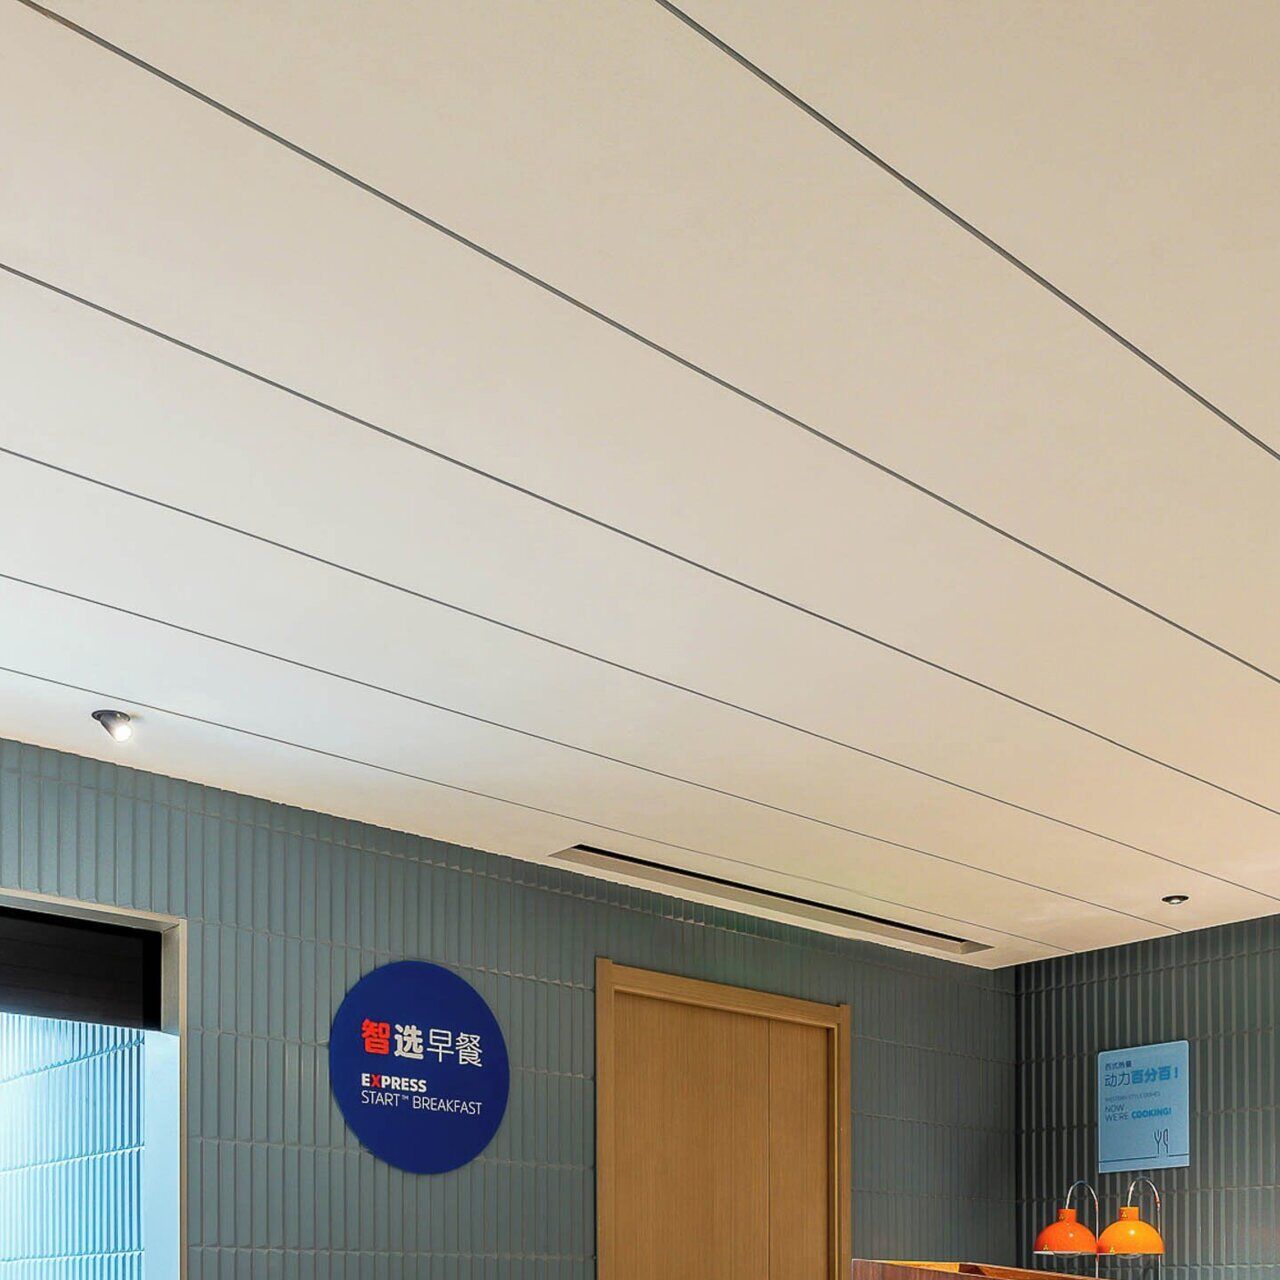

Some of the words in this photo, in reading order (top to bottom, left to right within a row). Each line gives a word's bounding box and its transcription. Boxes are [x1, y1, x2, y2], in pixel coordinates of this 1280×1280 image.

[361, 1018, 483, 1067] 智选早餐
[361, 1073, 427, 1093] EXPRESS
[412, 1095, 482, 1115] BREAKFAST
[1105, 1103, 1124, 1113] NOW
